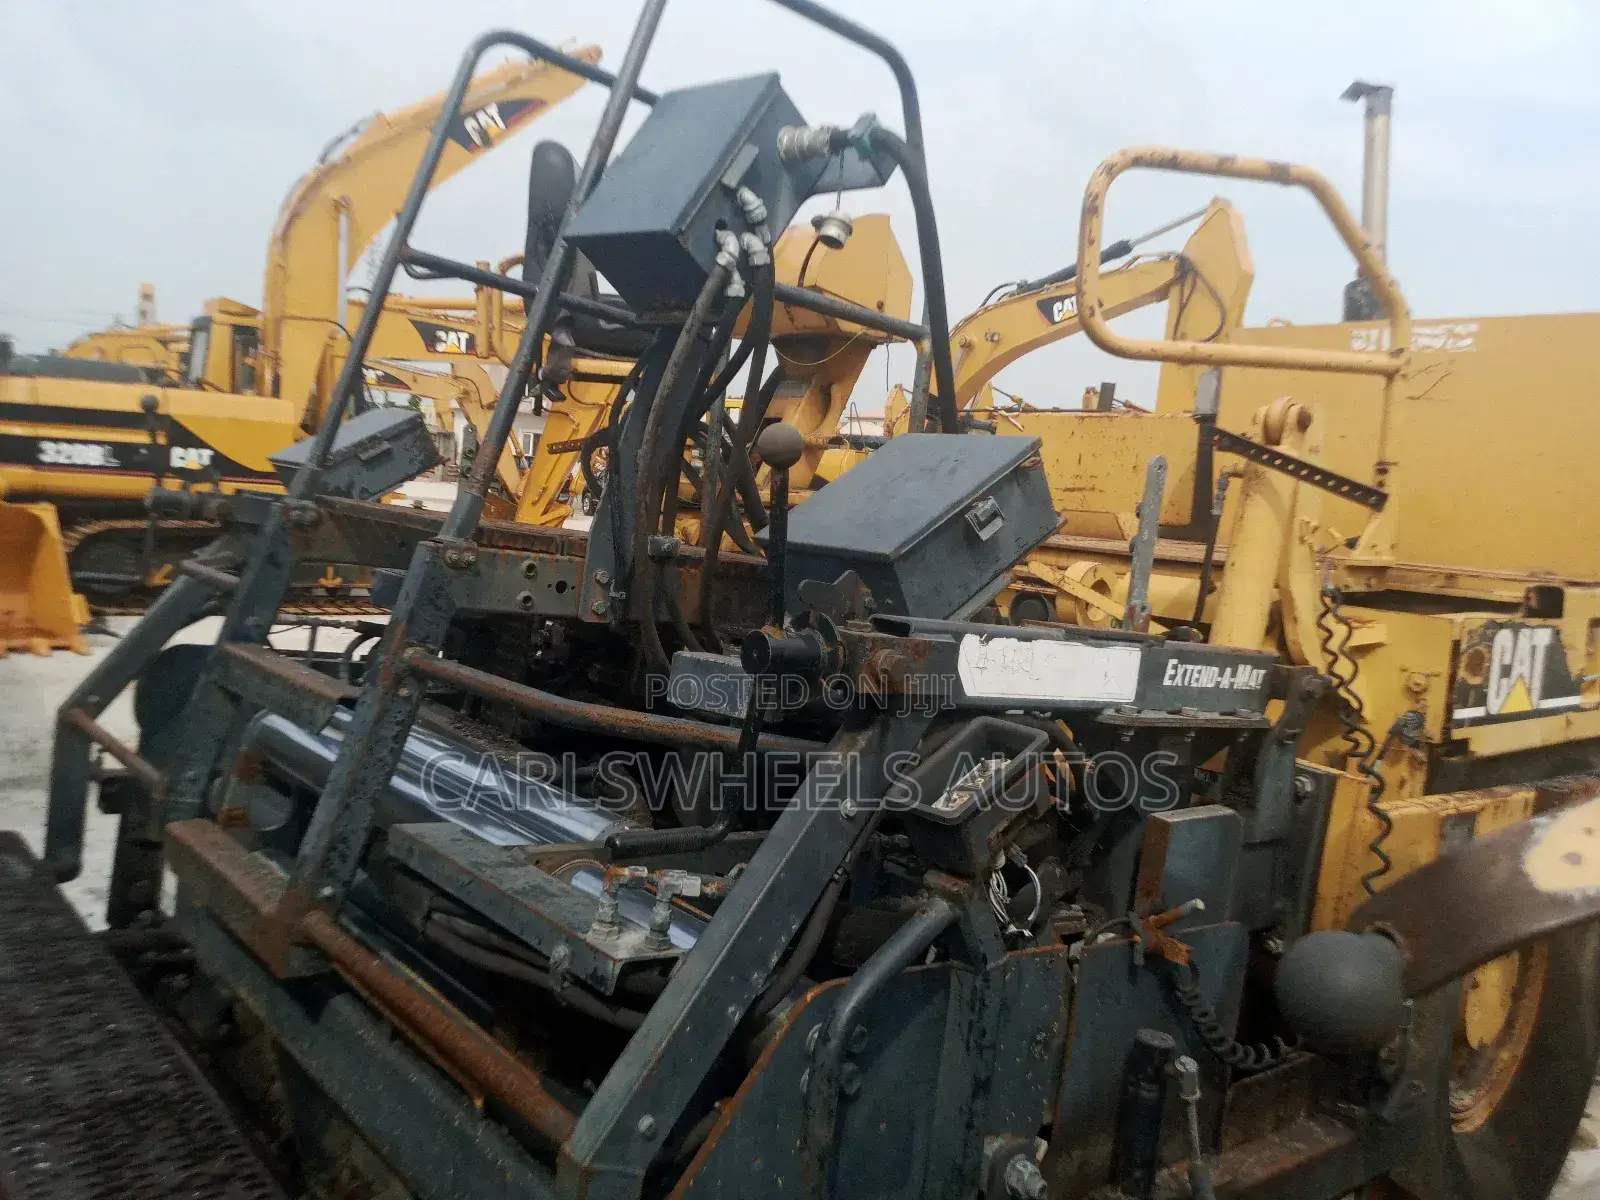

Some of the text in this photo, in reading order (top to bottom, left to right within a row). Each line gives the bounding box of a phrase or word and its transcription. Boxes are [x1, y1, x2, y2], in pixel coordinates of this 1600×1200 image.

[464, 102, 507, 147] CAT
[434, 330, 470, 354] CAT
[170, 446, 215, 469] CAT
[1486, 628, 1554, 715] CAT
